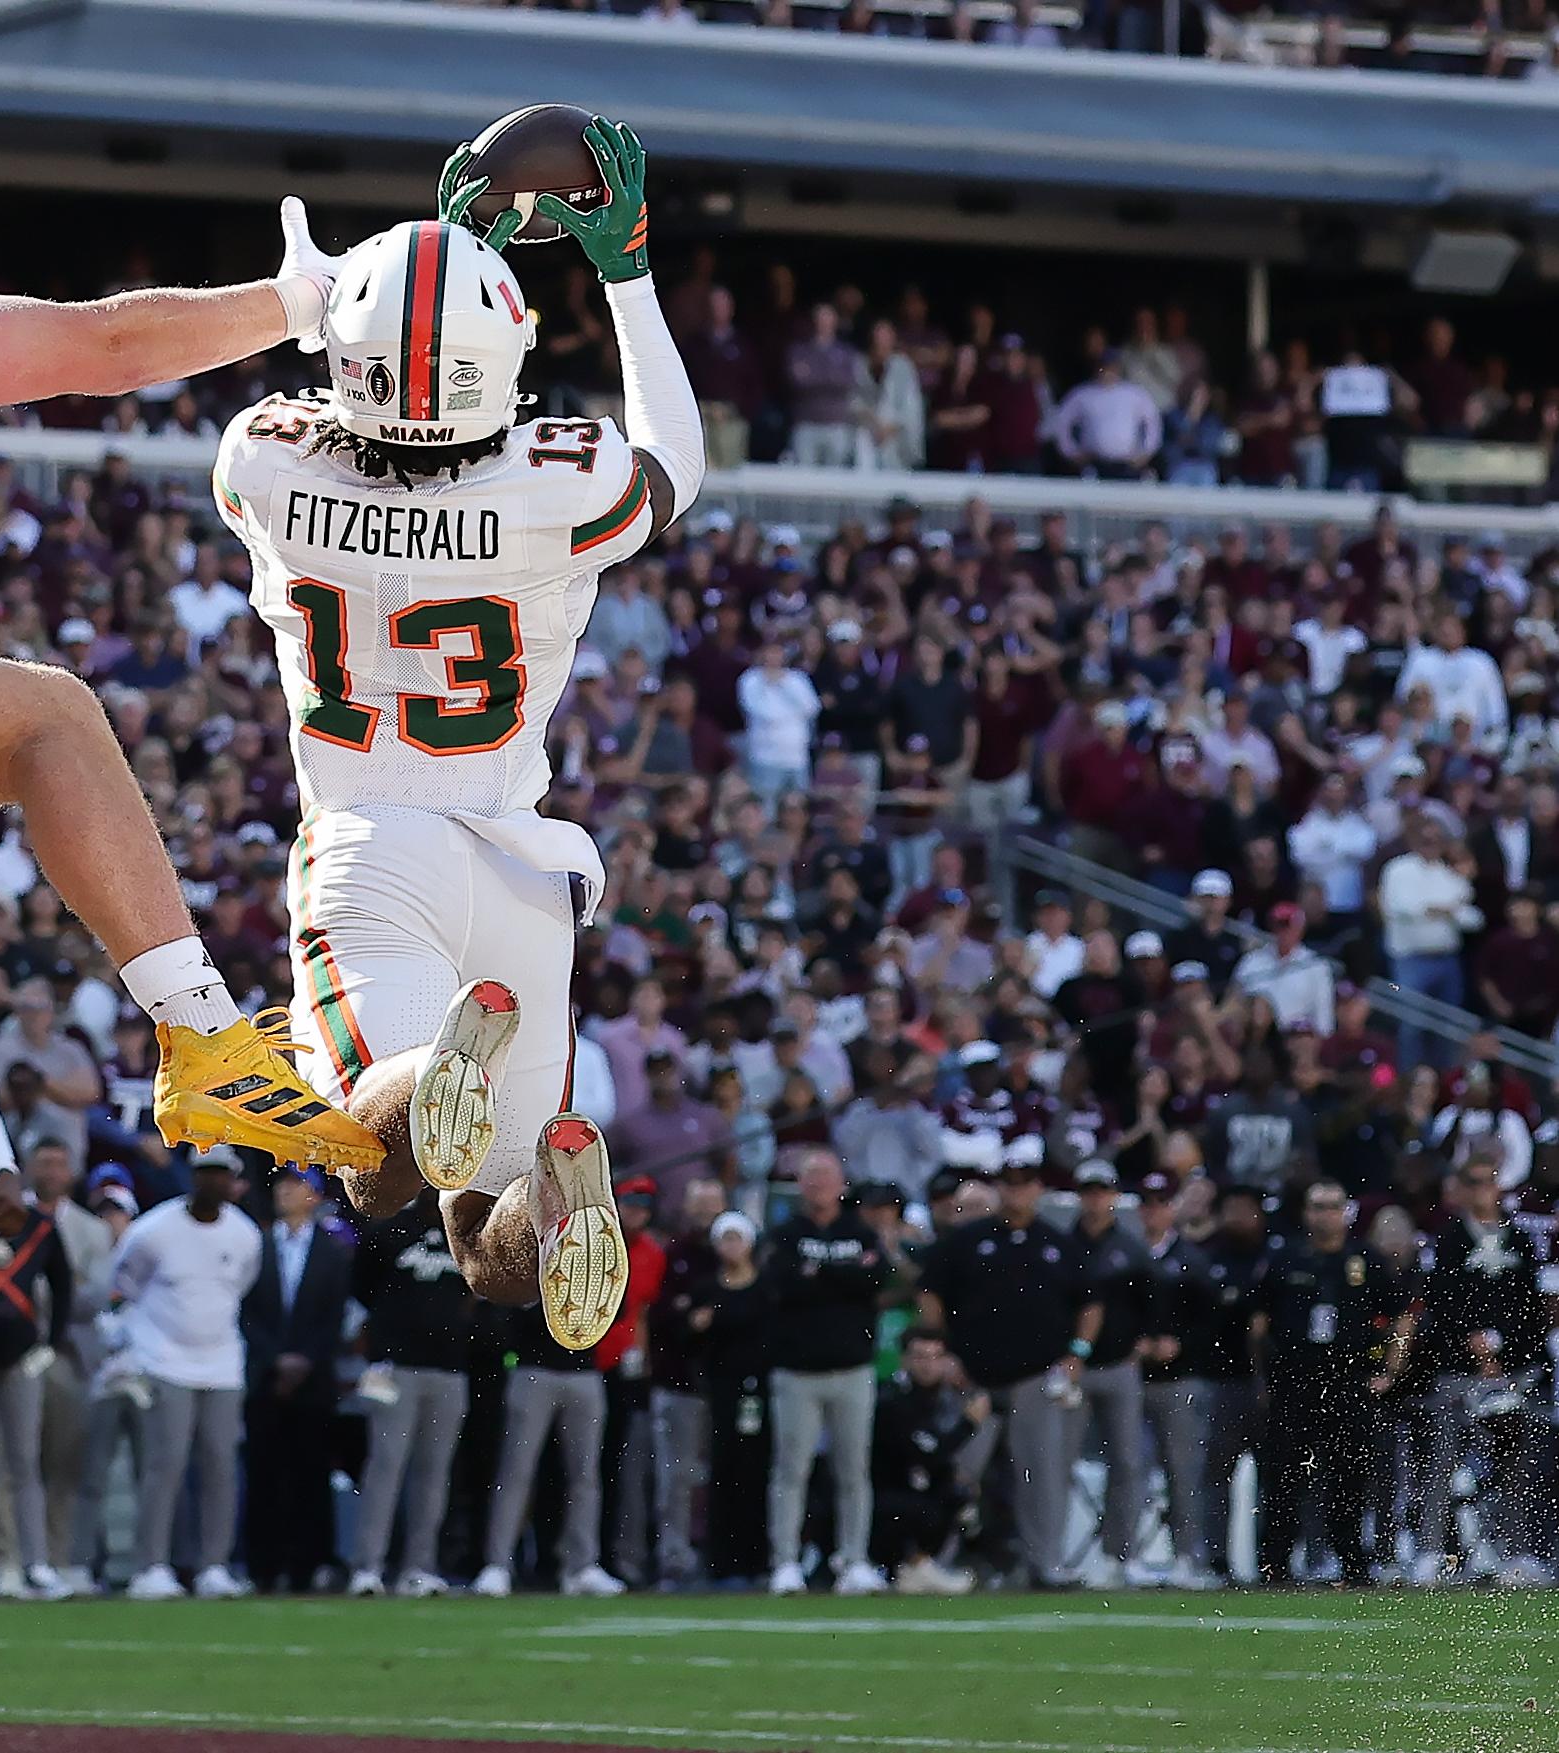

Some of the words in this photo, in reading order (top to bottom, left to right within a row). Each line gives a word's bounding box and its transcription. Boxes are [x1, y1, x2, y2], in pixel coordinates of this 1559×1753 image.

[454, 370, 479, 381] ACC
[379, 424, 455, 443] MIAMI
[528, 420, 603, 474] 13
[286, 490, 500, 561] FITZGERALD
[286, 576, 528, 757] 13
